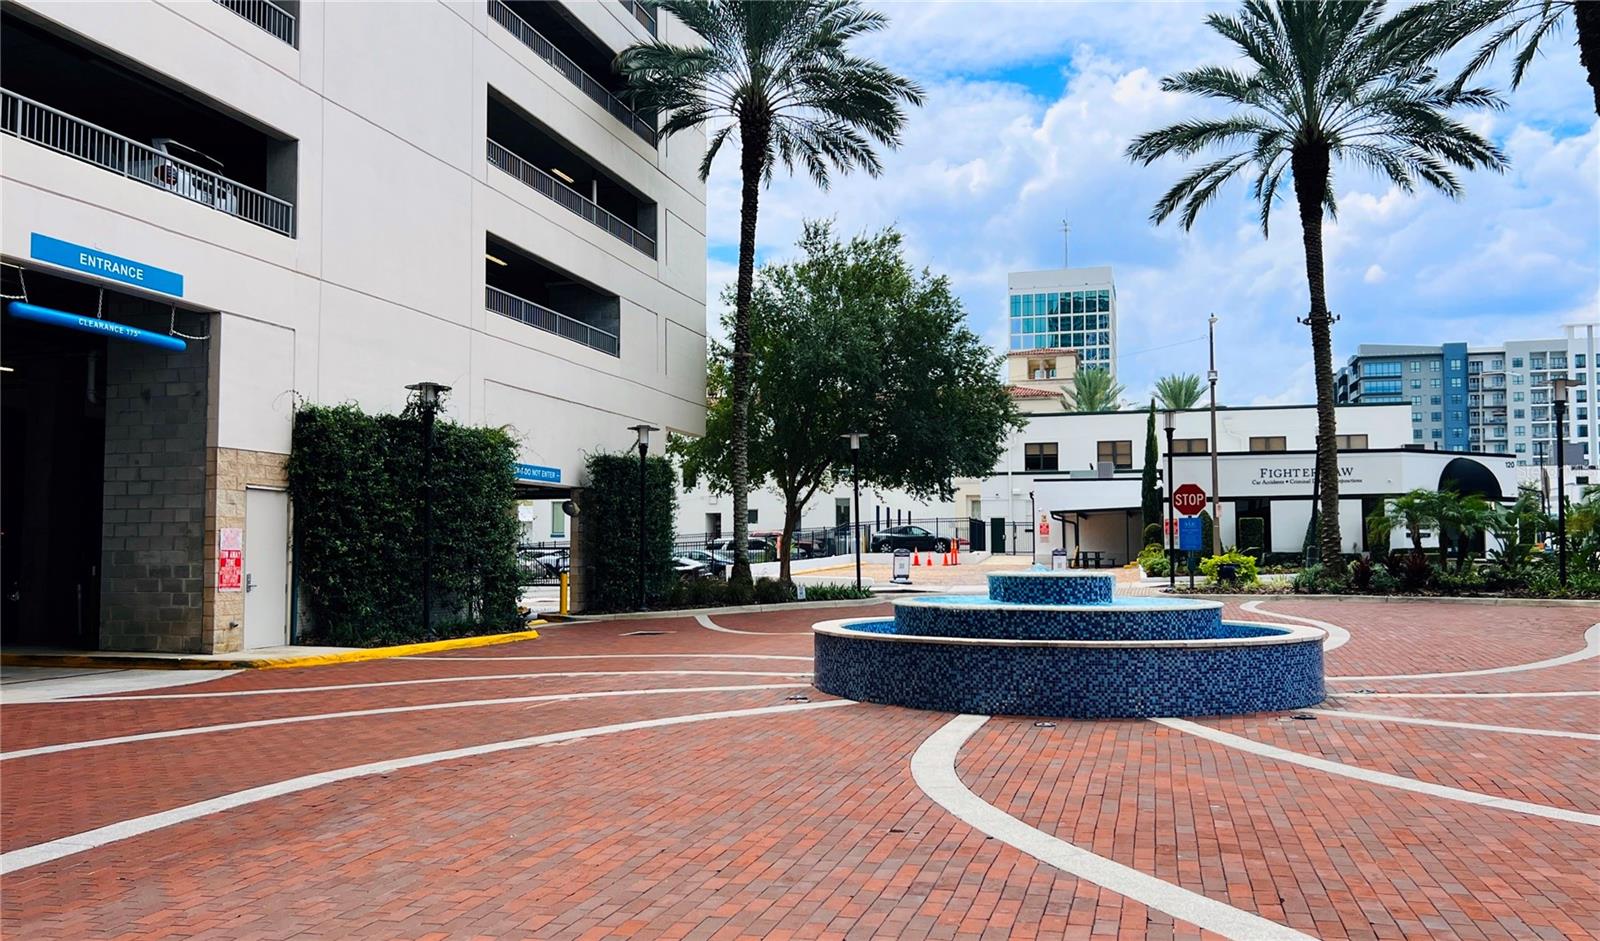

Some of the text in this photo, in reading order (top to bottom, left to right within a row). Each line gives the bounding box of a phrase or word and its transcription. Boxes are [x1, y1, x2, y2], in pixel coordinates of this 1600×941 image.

[79, 253, 144, 281] ENTRANCE
[78, 318, 124, 334] CLEARANCE
[1505, 461, 1515, 469] 120
[542, 470, 556, 478] ENTER
[1175, 493, 1204, 506] STOP
